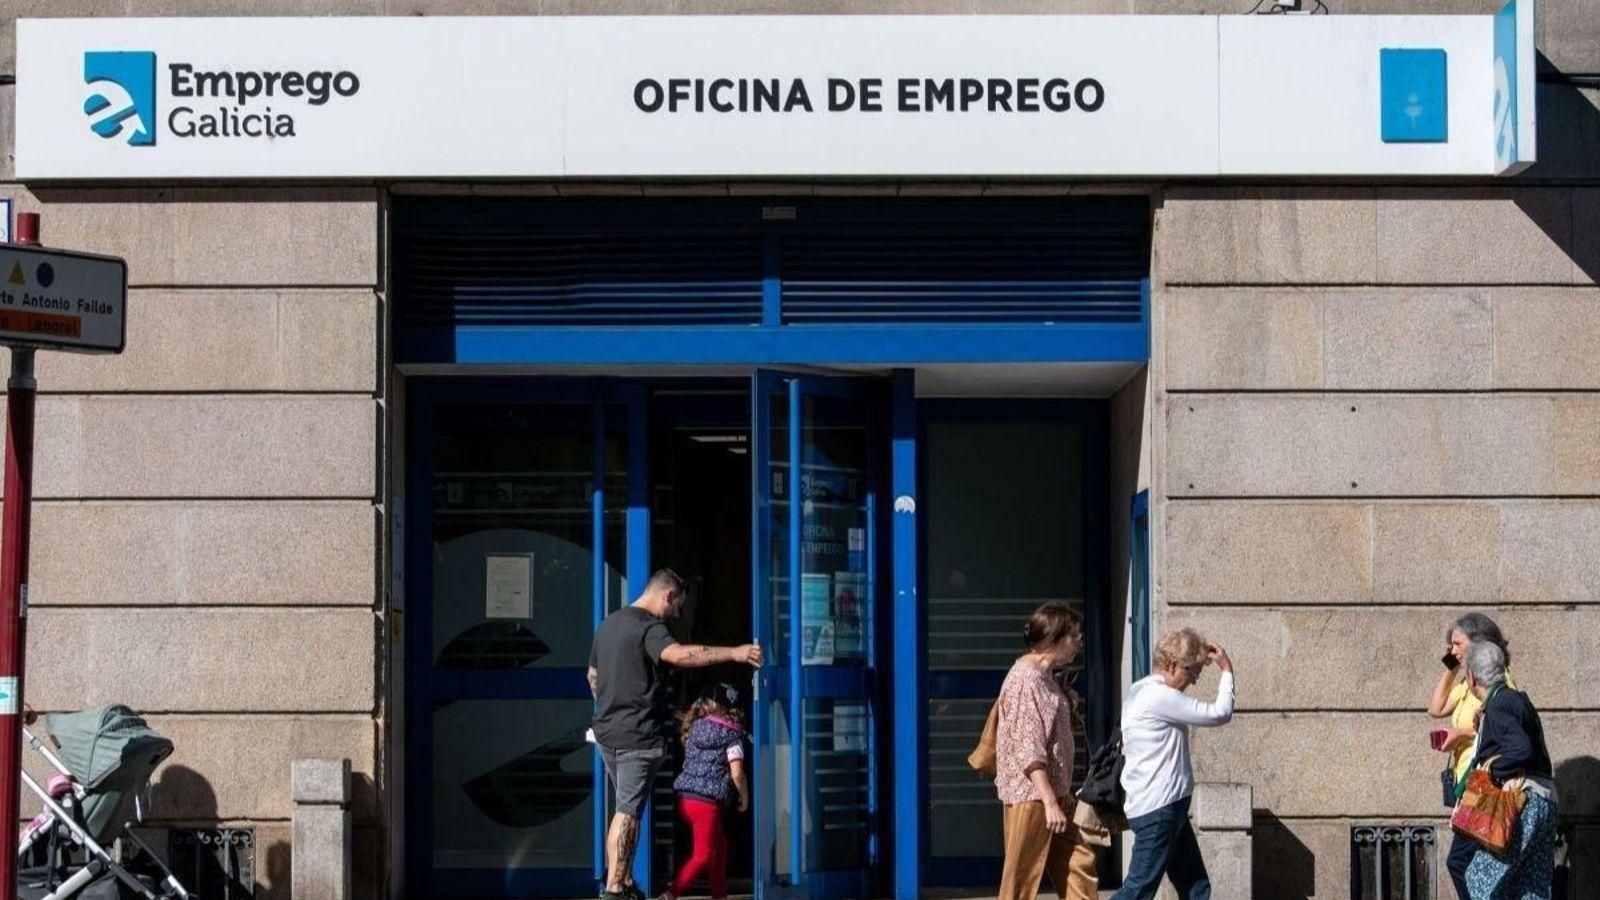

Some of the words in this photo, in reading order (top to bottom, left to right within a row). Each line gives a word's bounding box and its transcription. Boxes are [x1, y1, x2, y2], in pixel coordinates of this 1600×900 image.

[168, 63, 360, 106] Emprego
[633, 77, 814, 113] OFICINA
[827, 78, 883, 112] DE
[897, 77, 1105, 113] EMPREGO
[168, 106, 296, 138] Galicia
[22, 292, 70, 311] Antonio
